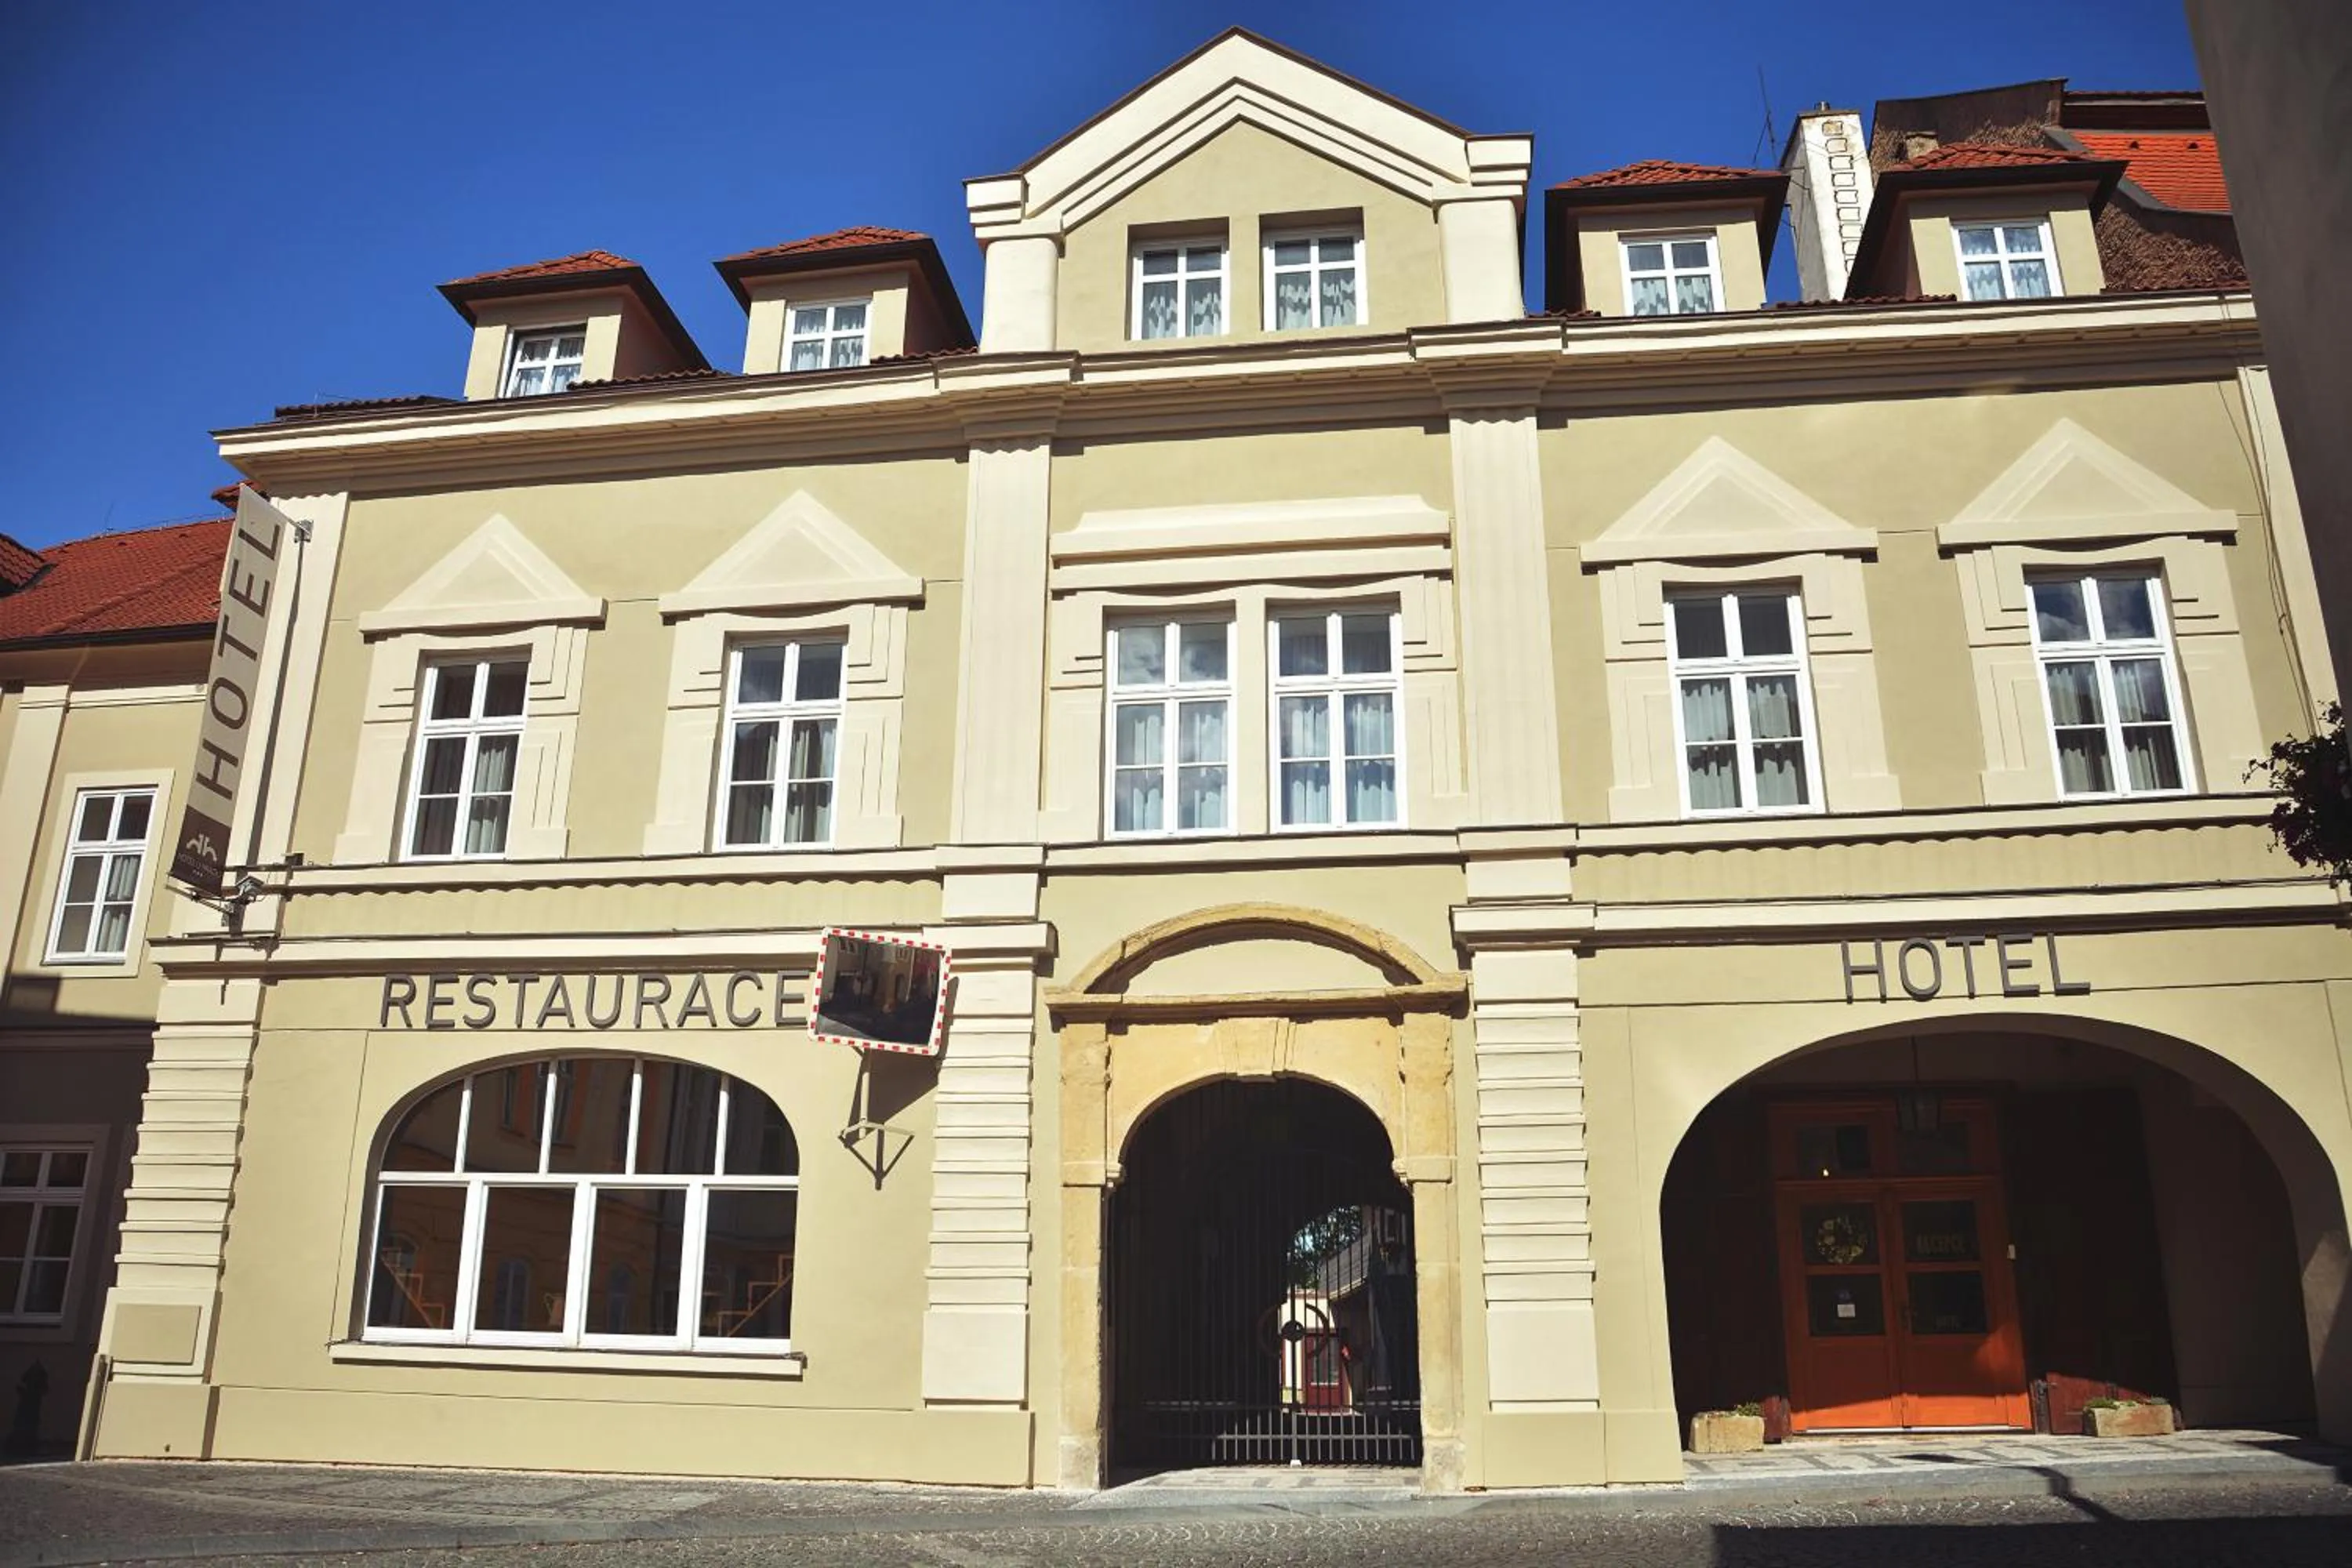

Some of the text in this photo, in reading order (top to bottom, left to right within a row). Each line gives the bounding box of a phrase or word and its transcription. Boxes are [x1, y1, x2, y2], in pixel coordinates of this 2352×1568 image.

[195, 524, 280, 800] HOTEL
[380, 971, 810, 1029] RESTAURACE
[1841, 932, 2091, 1004] HOTEL
